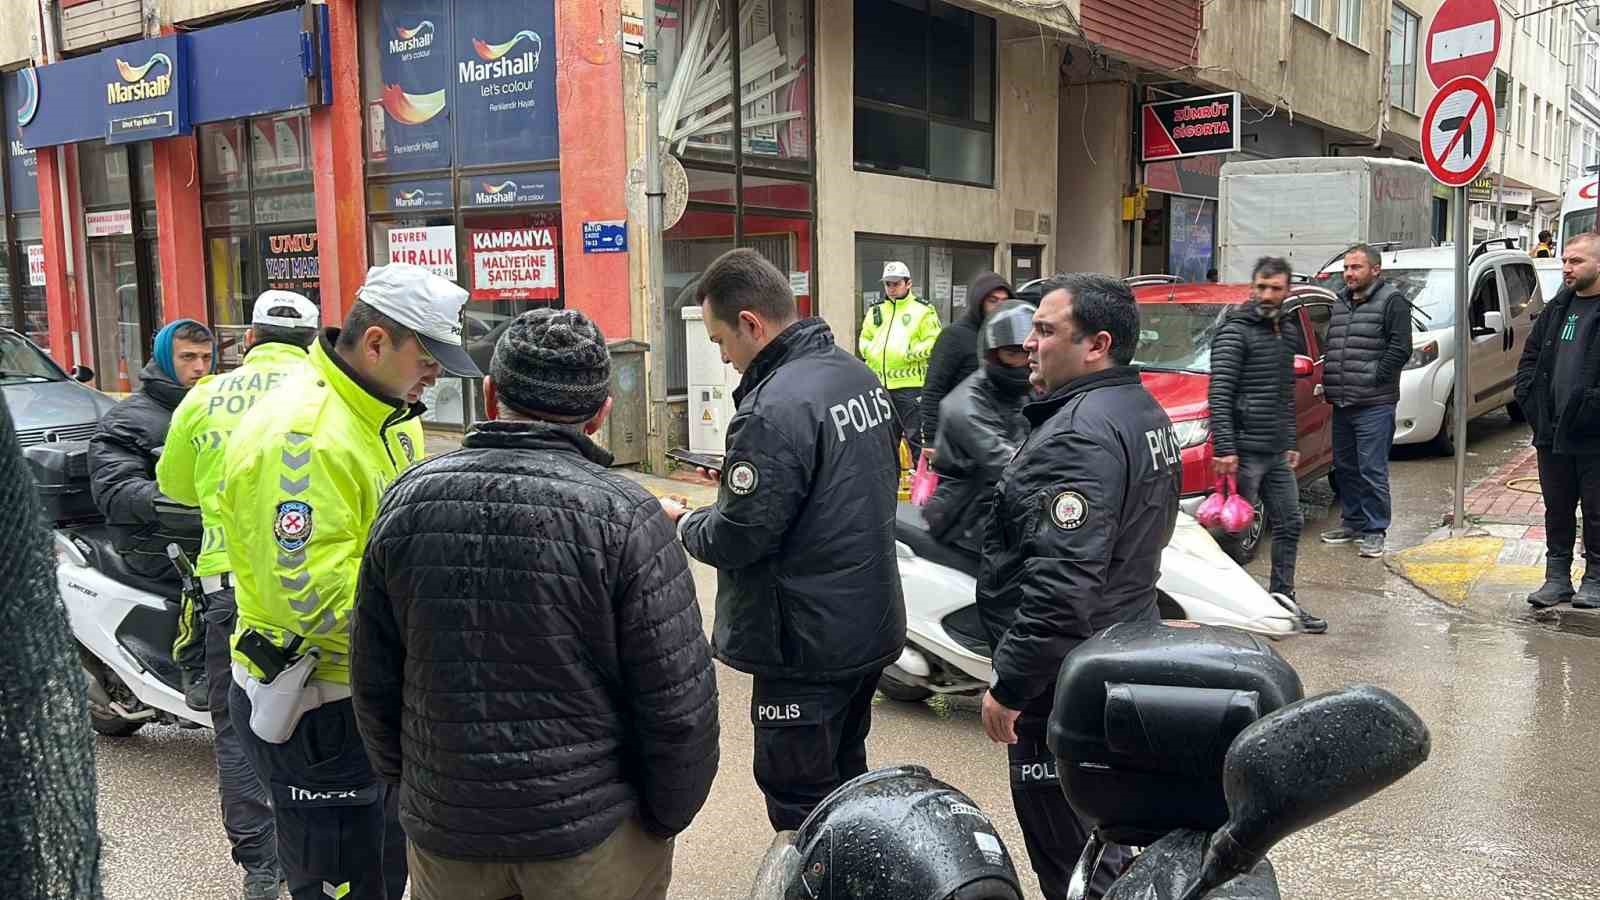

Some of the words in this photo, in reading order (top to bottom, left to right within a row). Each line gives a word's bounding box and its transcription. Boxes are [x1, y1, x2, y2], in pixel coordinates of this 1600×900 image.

[389, 33, 431, 54] Marshall
[459, 52, 535, 83] Marshall
[107, 75, 168, 105] Marshall
[481, 83, 500, 97] let's
[502, 79, 534, 94] colour
[1173, 101, 1229, 122] ZÜMRÜT
[1172, 121, 1230, 139] SİGORTA
[476, 191, 513, 205] Marshall
[391, 231, 427, 243] DEVREN
[473, 229, 553, 250] KAMPANYA
[392, 246, 454, 265] KİRALIK
[482, 254, 547, 269] MALİYETİNE
[829, 388, 892, 442] POLİS
[758, 703, 800, 720] POLİS
